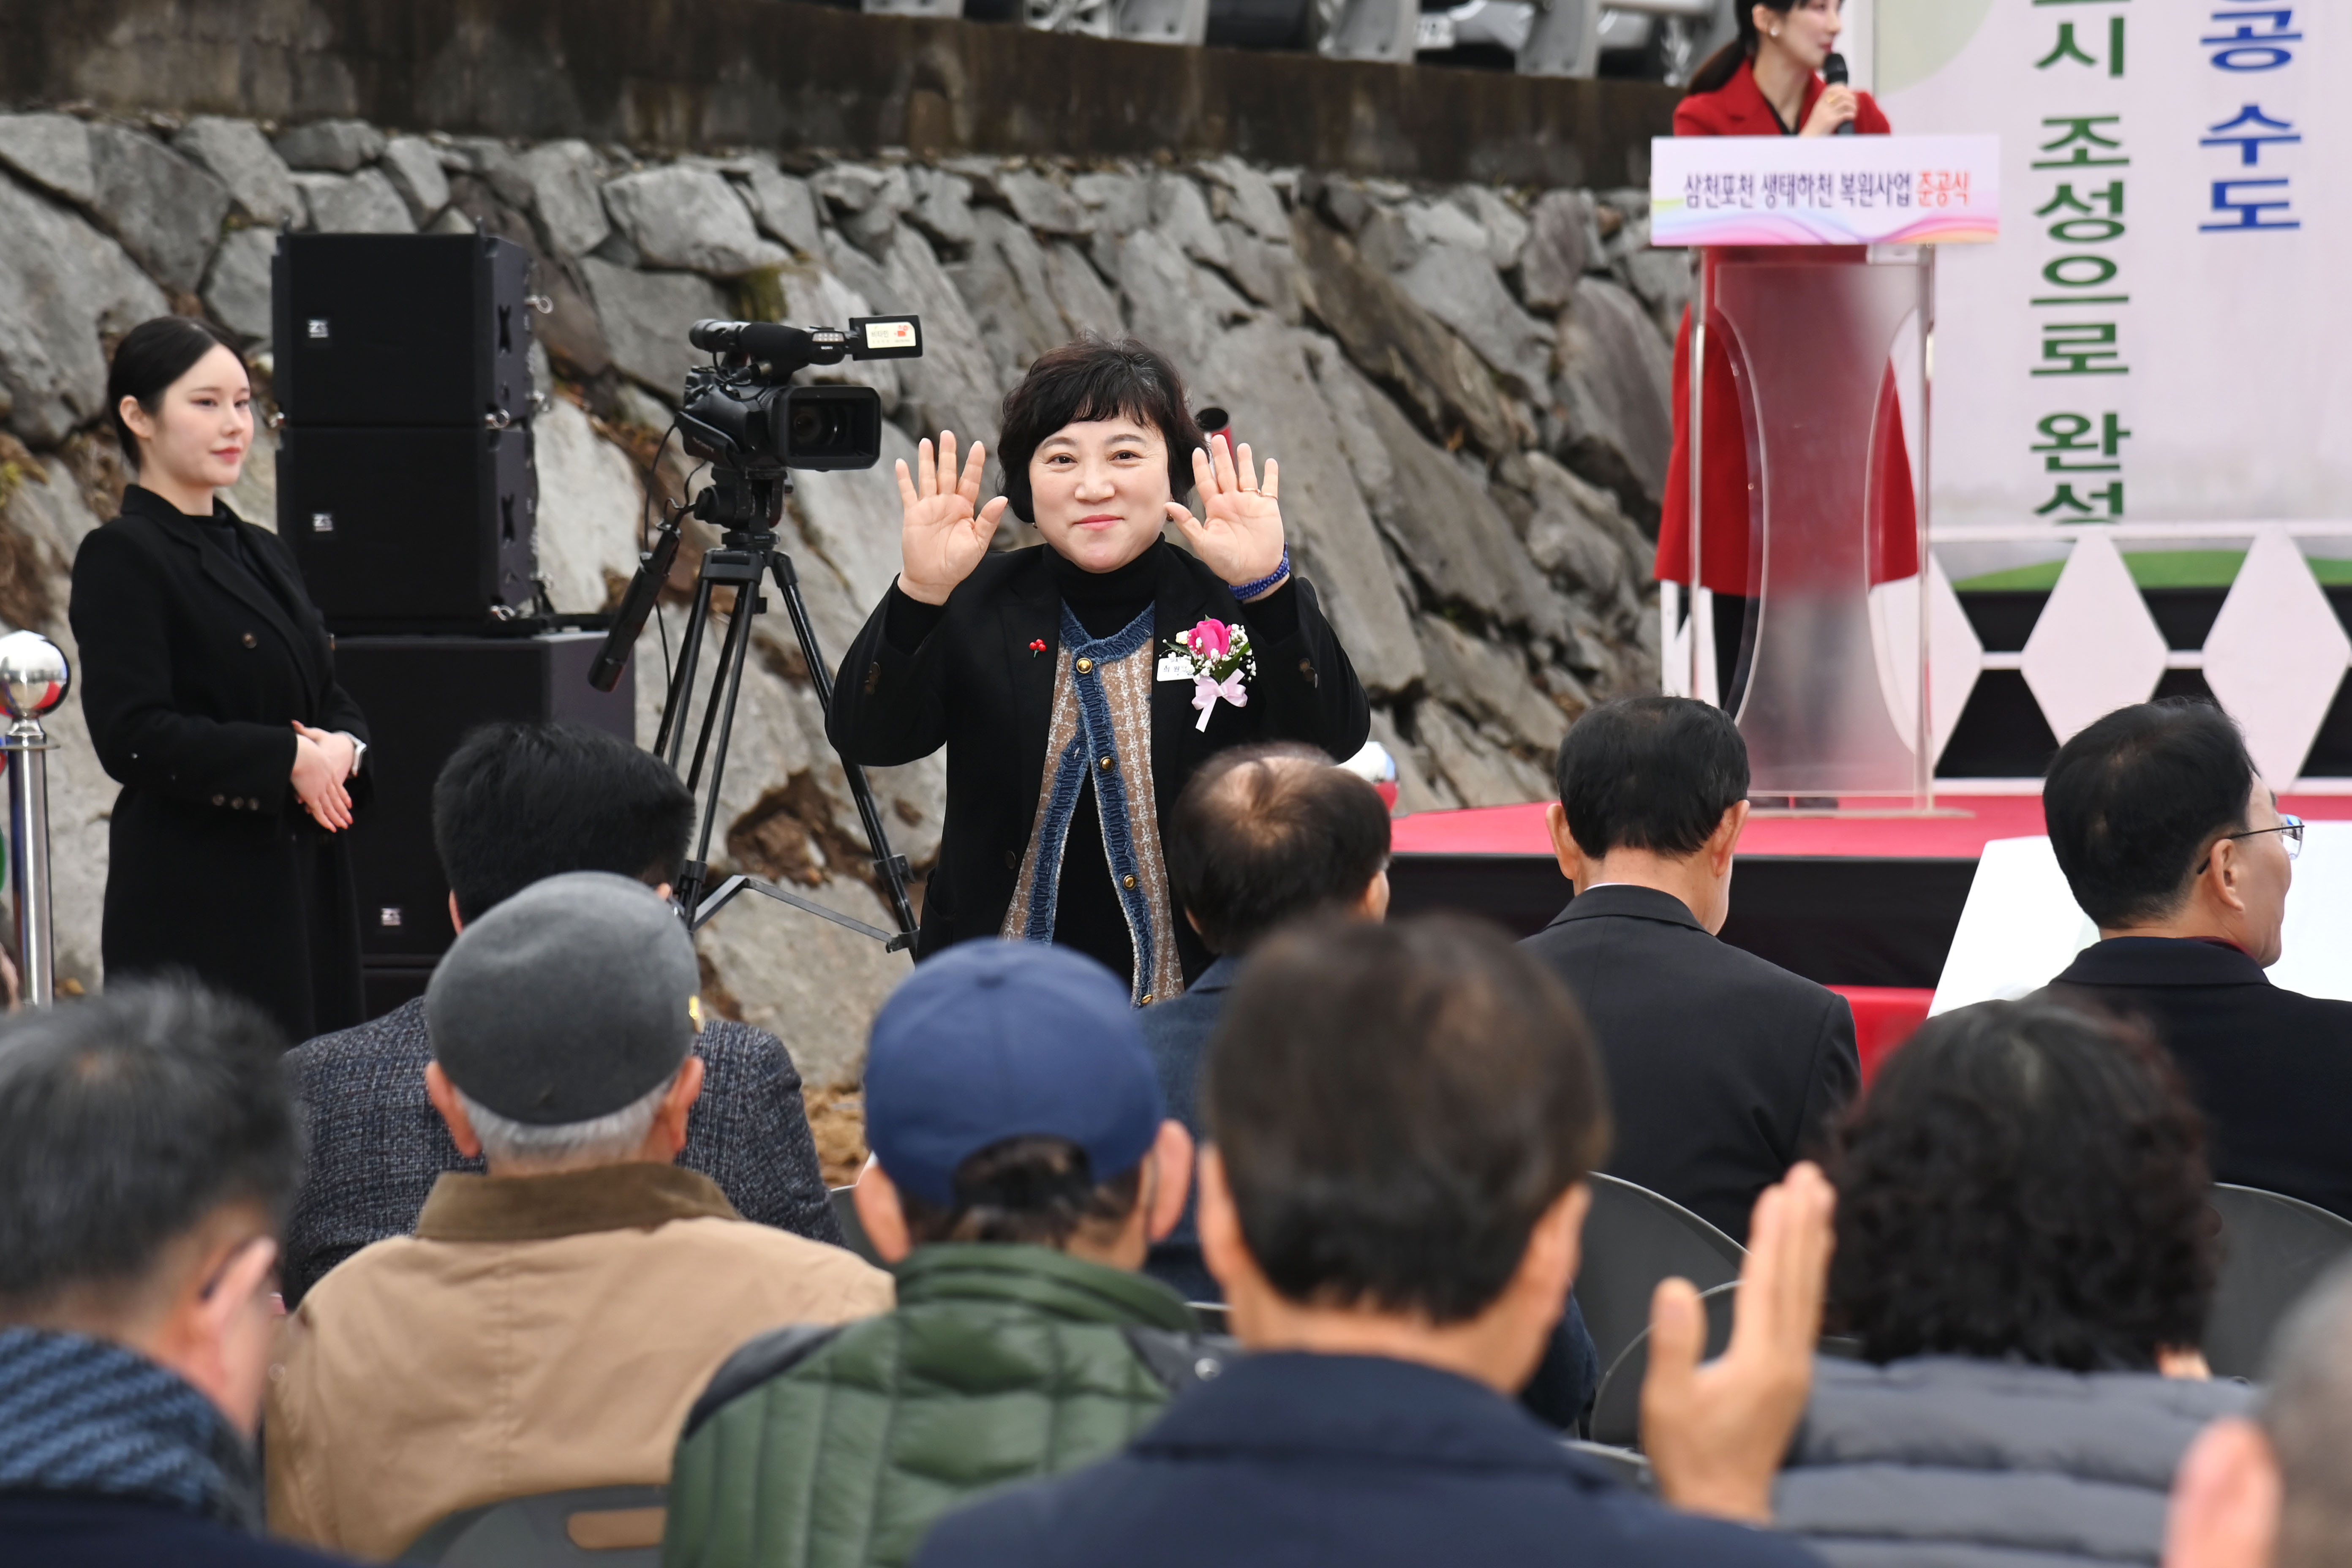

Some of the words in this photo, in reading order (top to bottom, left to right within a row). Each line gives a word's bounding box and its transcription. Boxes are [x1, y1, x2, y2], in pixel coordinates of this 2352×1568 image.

[2029, 0, 2132, 78] 시
[2199, 0, 2303, 73] 공
[1684, 173, 1754, 209] 삼천포천
[1761, 172, 1833, 209] 생태하천
[1839, 172, 1912, 208] 복원사업
[1916, 170, 1970, 208] 준공식
[2197, 103, 2302, 233] 수도
[2028, 114, 2131, 378] 조성으로
